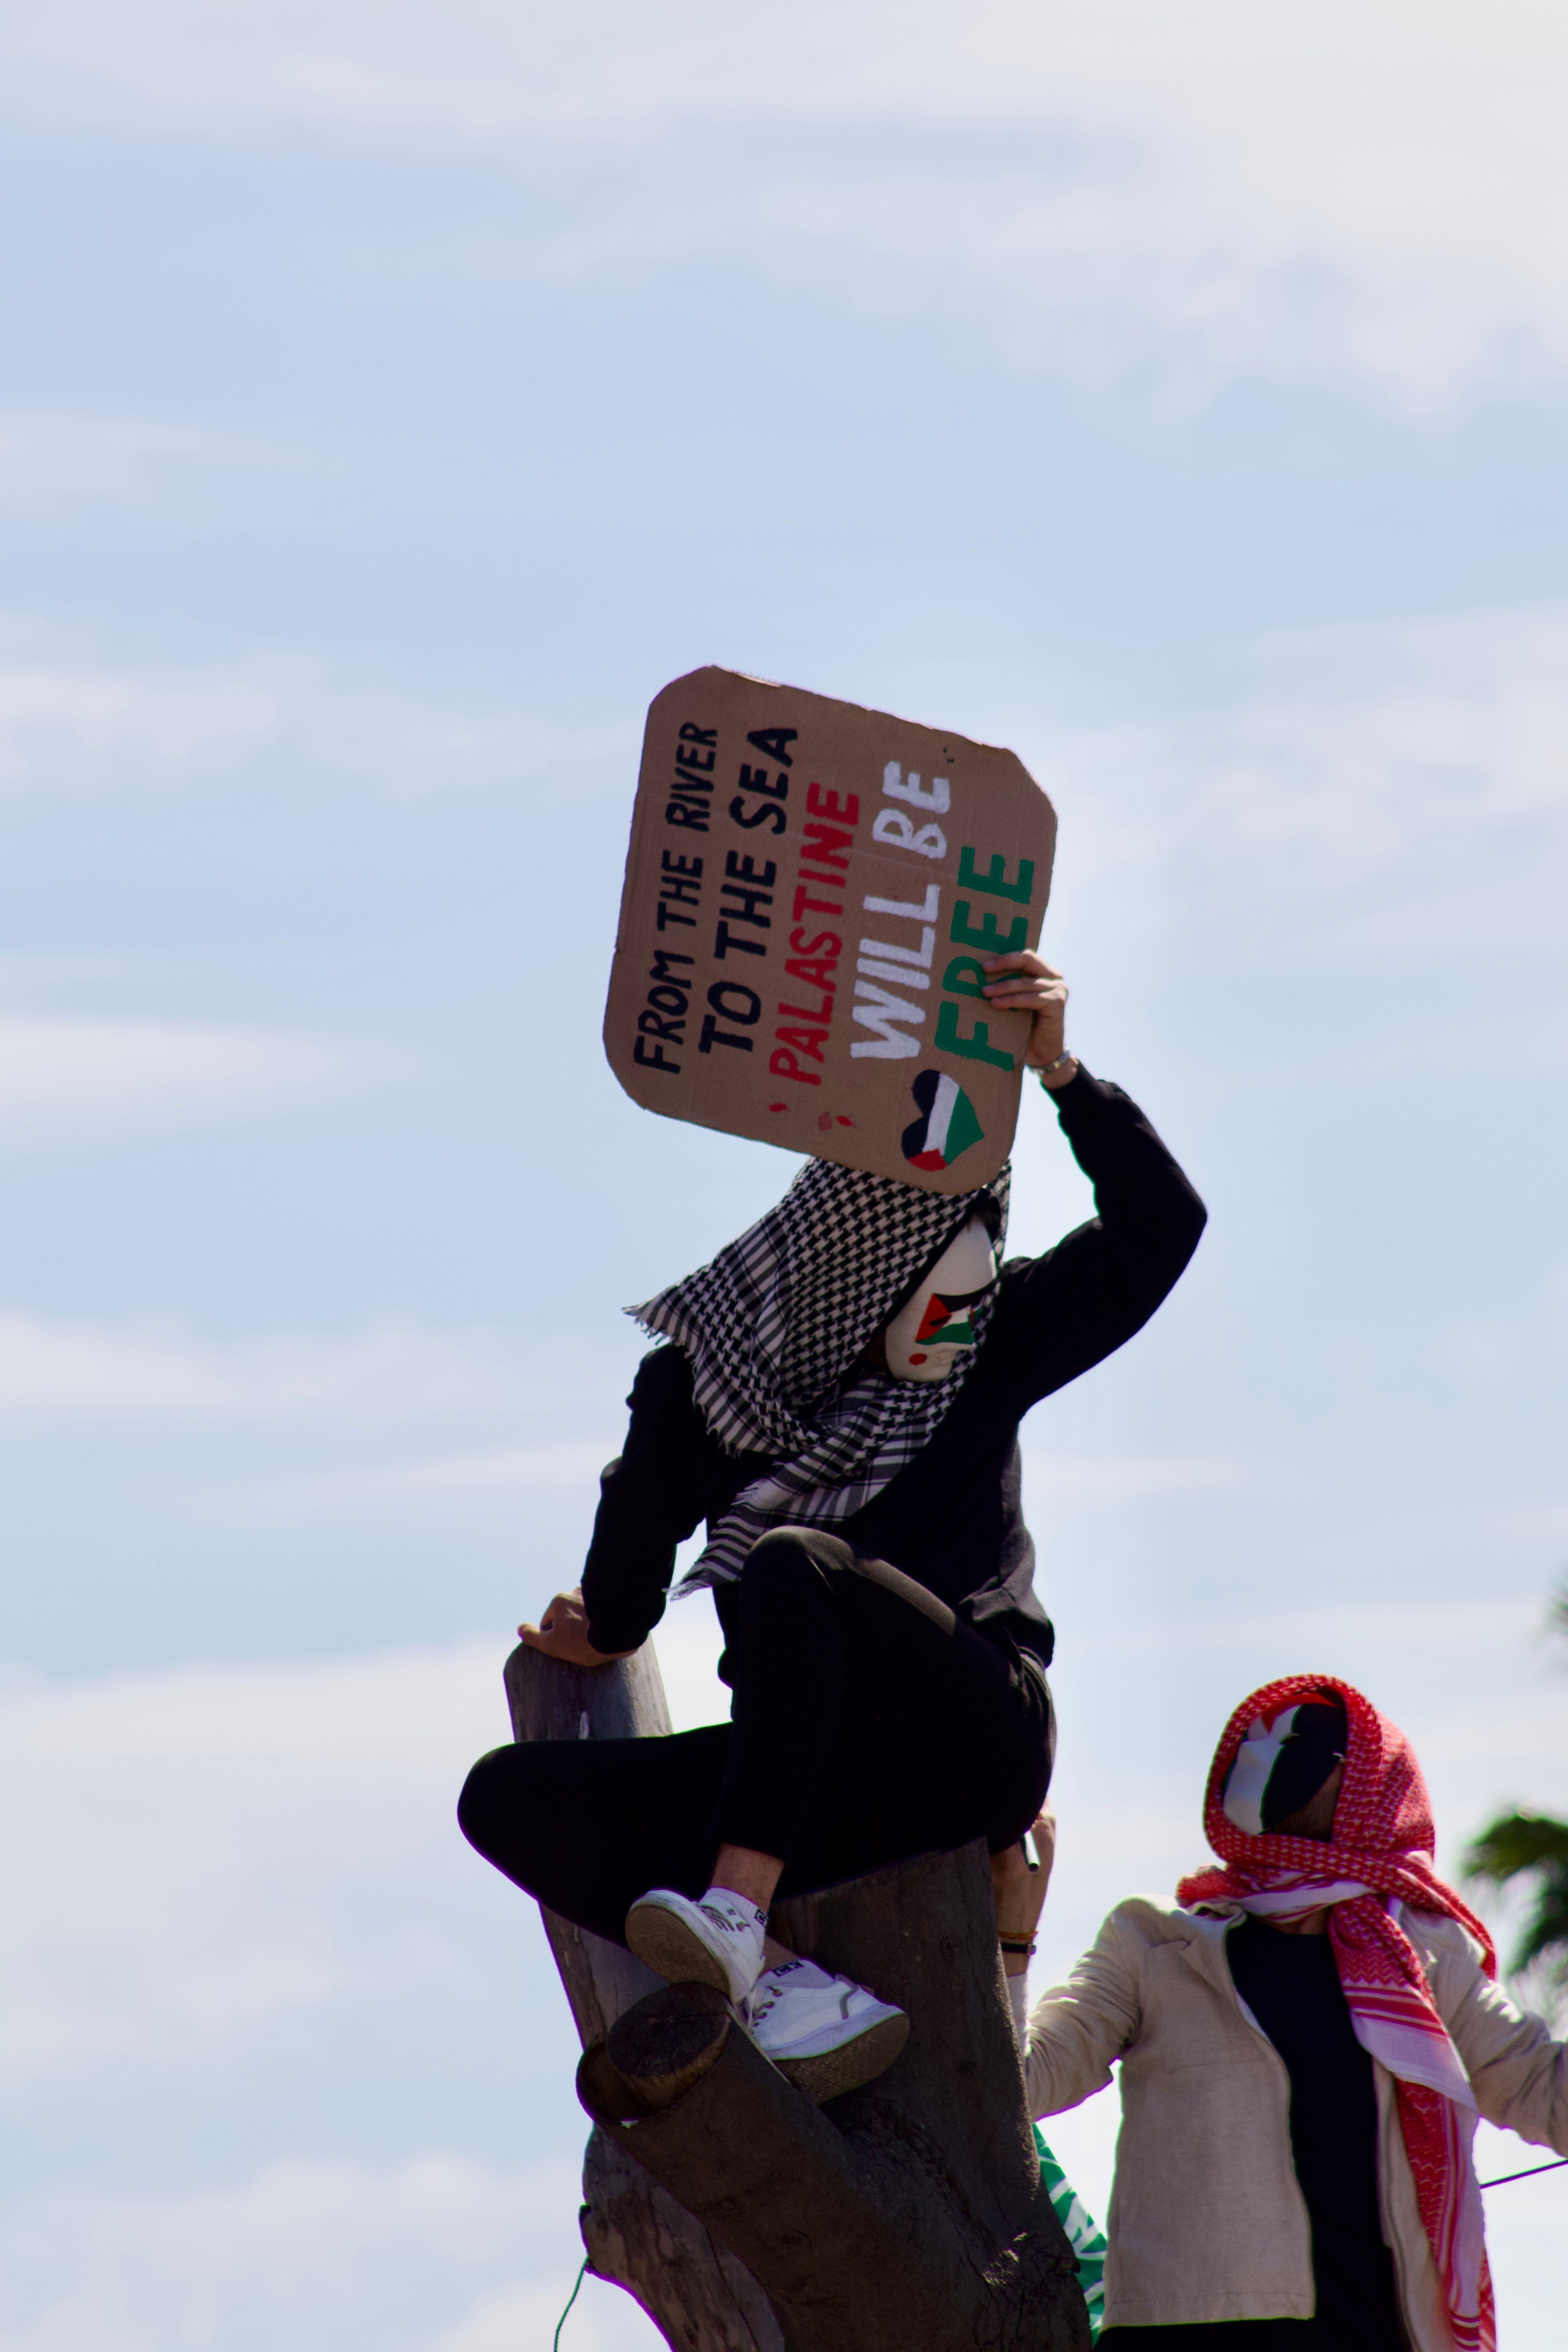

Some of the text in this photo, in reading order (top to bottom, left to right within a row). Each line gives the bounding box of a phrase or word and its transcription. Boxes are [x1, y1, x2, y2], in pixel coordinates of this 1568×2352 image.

[633, 722, 717, 1074] FROM THE RIVER
[698, 728, 798, 1054] TO THE SEA
[769, 782, 859, 1085] PALASTINE
[850, 760, 950, 1059] WILL BE
